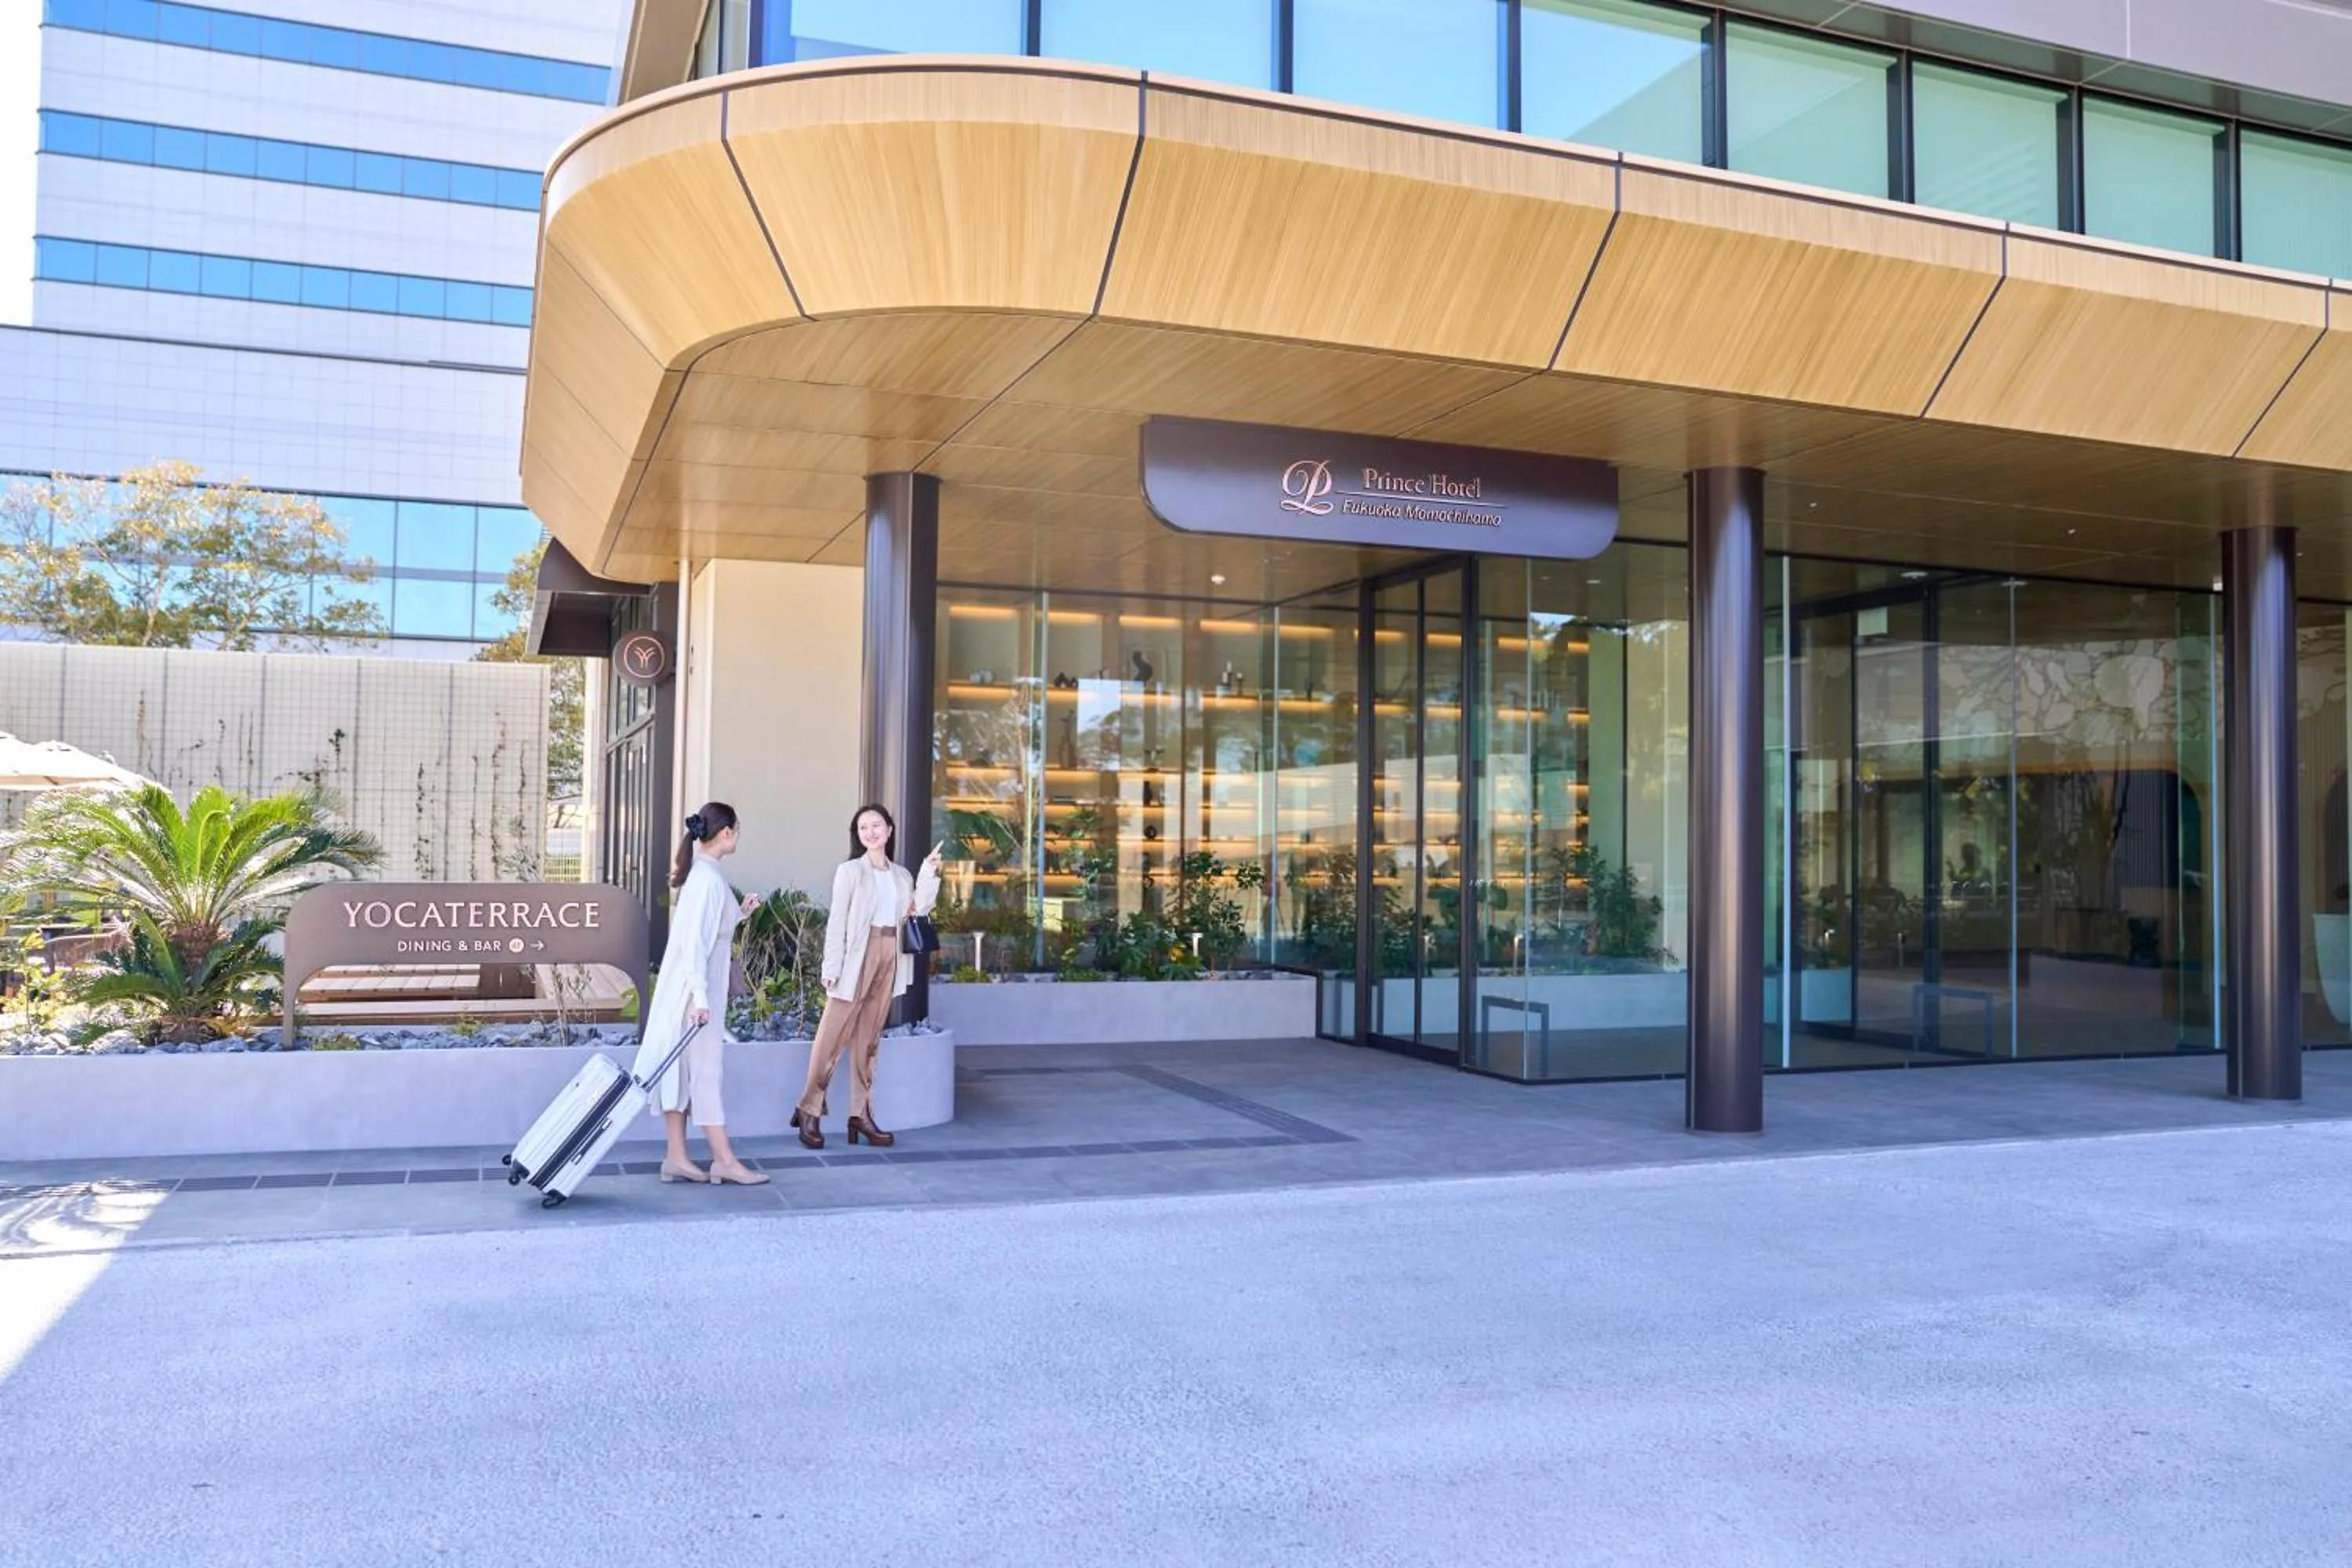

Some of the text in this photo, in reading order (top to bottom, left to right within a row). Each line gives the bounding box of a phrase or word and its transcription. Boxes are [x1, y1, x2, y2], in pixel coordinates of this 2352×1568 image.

[1363, 467, 1481, 498] Prince Hotel
[1342, 499, 1401, 517] Fukuoka
[343, 902, 600, 928] YOCATERRACE
[397, 940, 452, 952] DINING
[459, 940, 468, 951] &
[474, 940, 501, 951] BAR
